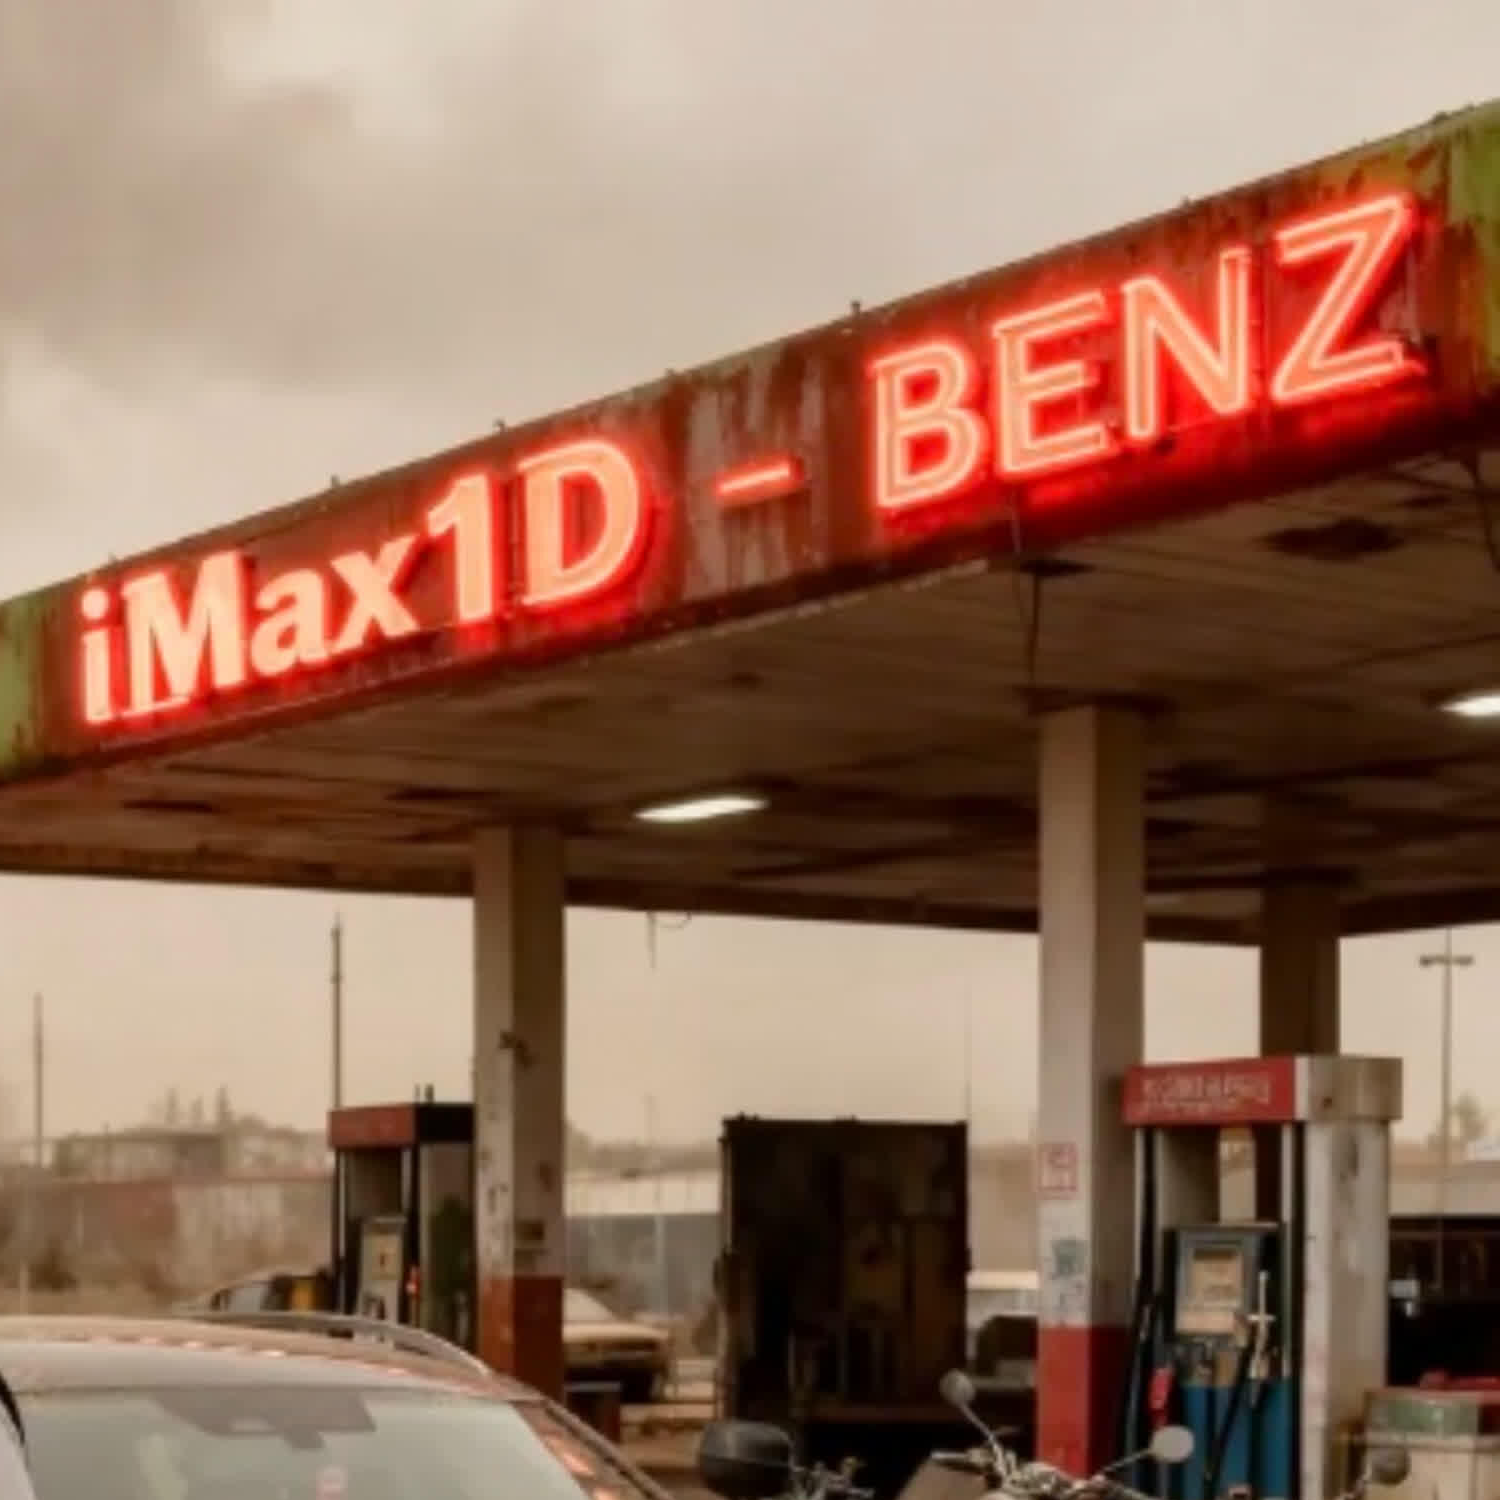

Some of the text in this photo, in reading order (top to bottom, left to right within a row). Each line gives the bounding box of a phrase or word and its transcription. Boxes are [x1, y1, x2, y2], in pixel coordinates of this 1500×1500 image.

[79, 194, 1408, 725] iMax1D - BENZ
